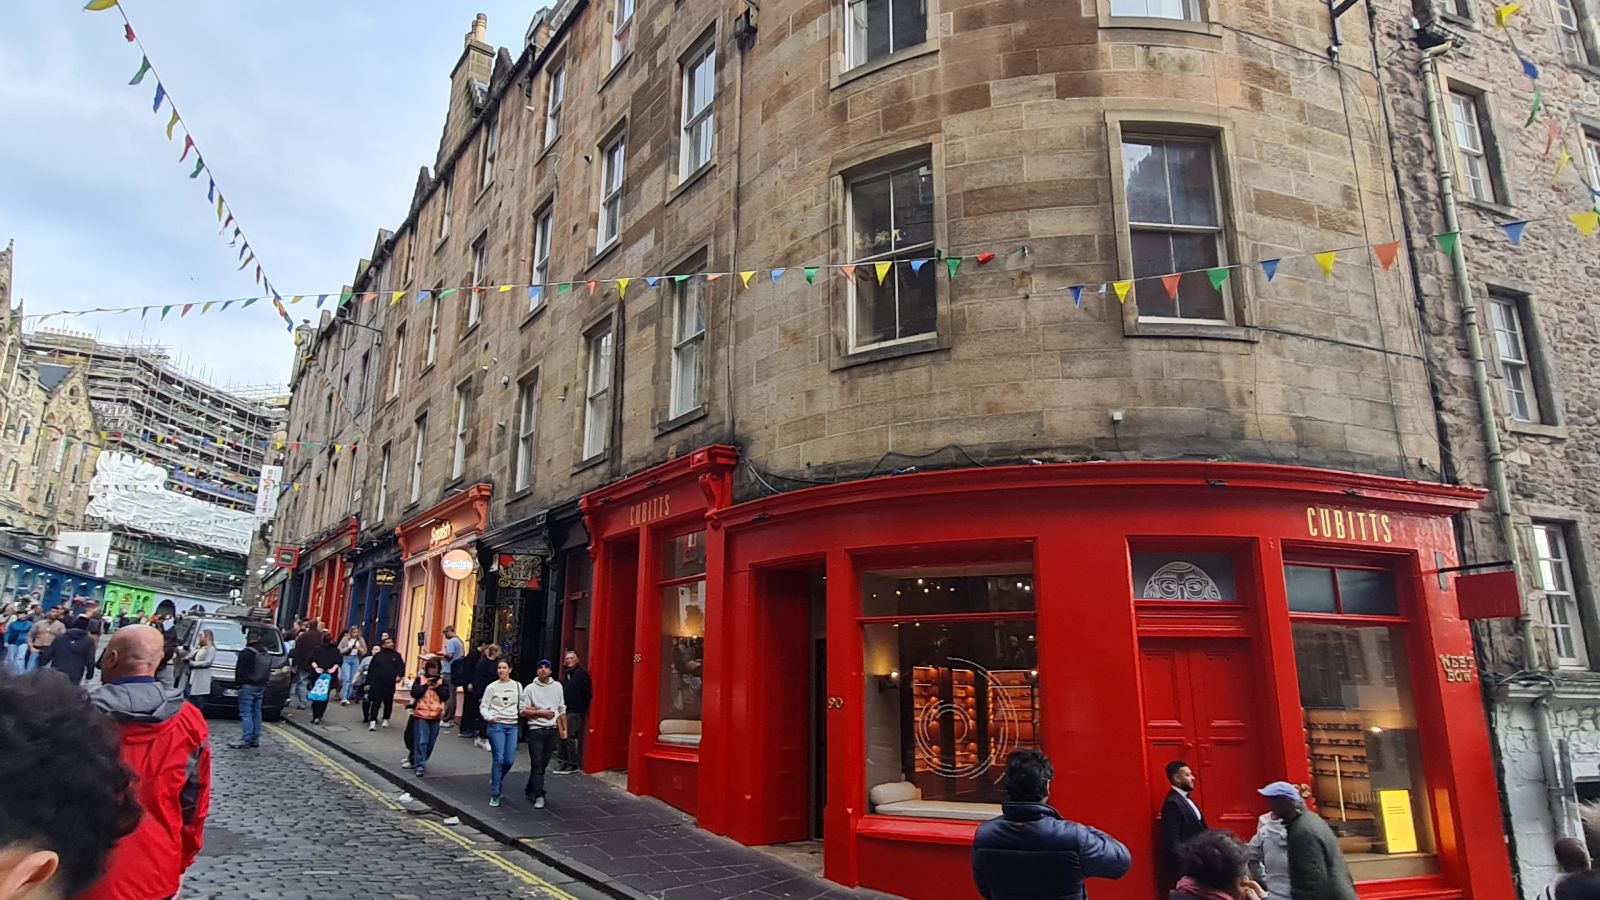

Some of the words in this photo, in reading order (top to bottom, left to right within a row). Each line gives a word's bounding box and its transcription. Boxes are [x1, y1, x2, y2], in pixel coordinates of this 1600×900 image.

[629, 494, 670, 526] CUBITTS
[1306, 506, 1393, 544] CUBITTS
[1438, 654, 1475, 669] WEST
[1446, 669, 1473, 682] BOW
[826, 696, 844, 710] 90
